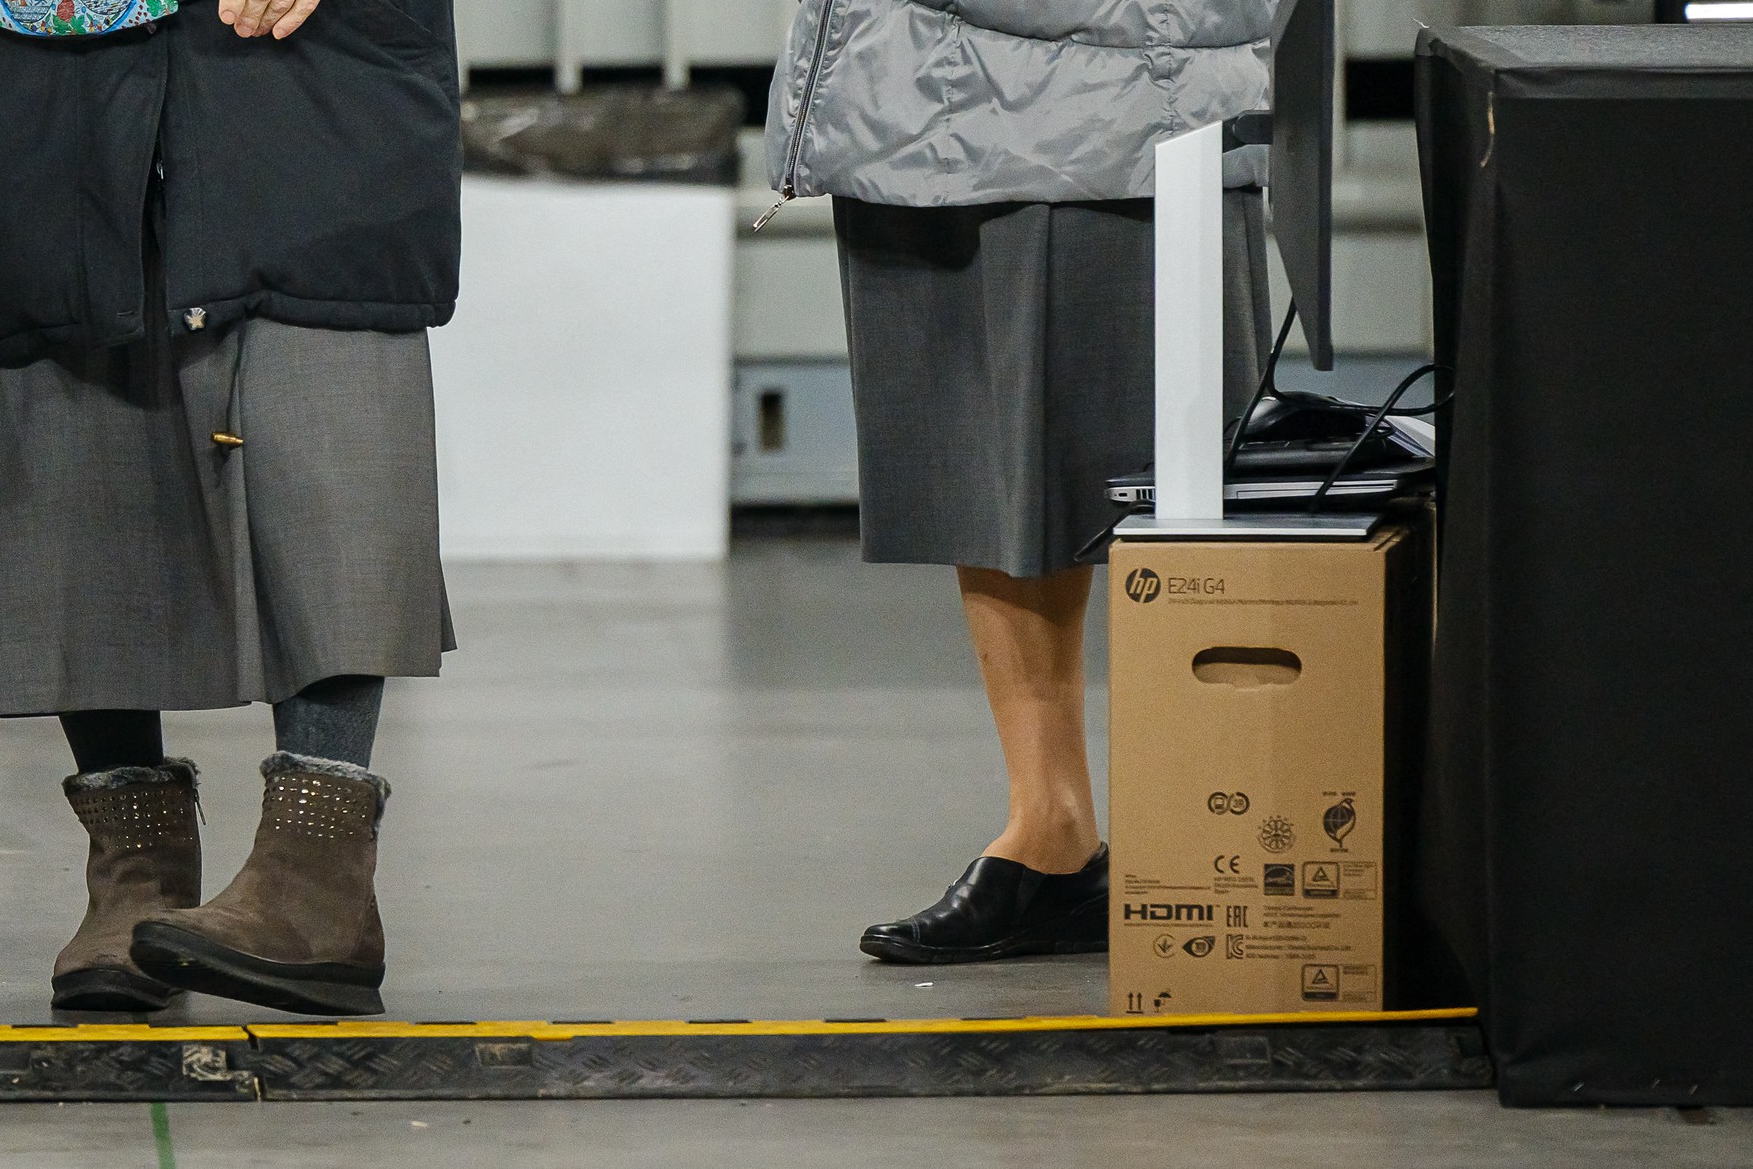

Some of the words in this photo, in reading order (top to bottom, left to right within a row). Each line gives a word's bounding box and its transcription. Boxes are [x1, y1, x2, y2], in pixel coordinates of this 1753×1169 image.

[1127, 568, 1160, 603] hp
[1167, 577, 1200, 594] E24i
[1205, 577, 1225, 594] G4
[1214, 855, 1240, 873] CE
[1124, 903, 1213, 920] HDMI
[1226, 905, 1249, 927] EAC
